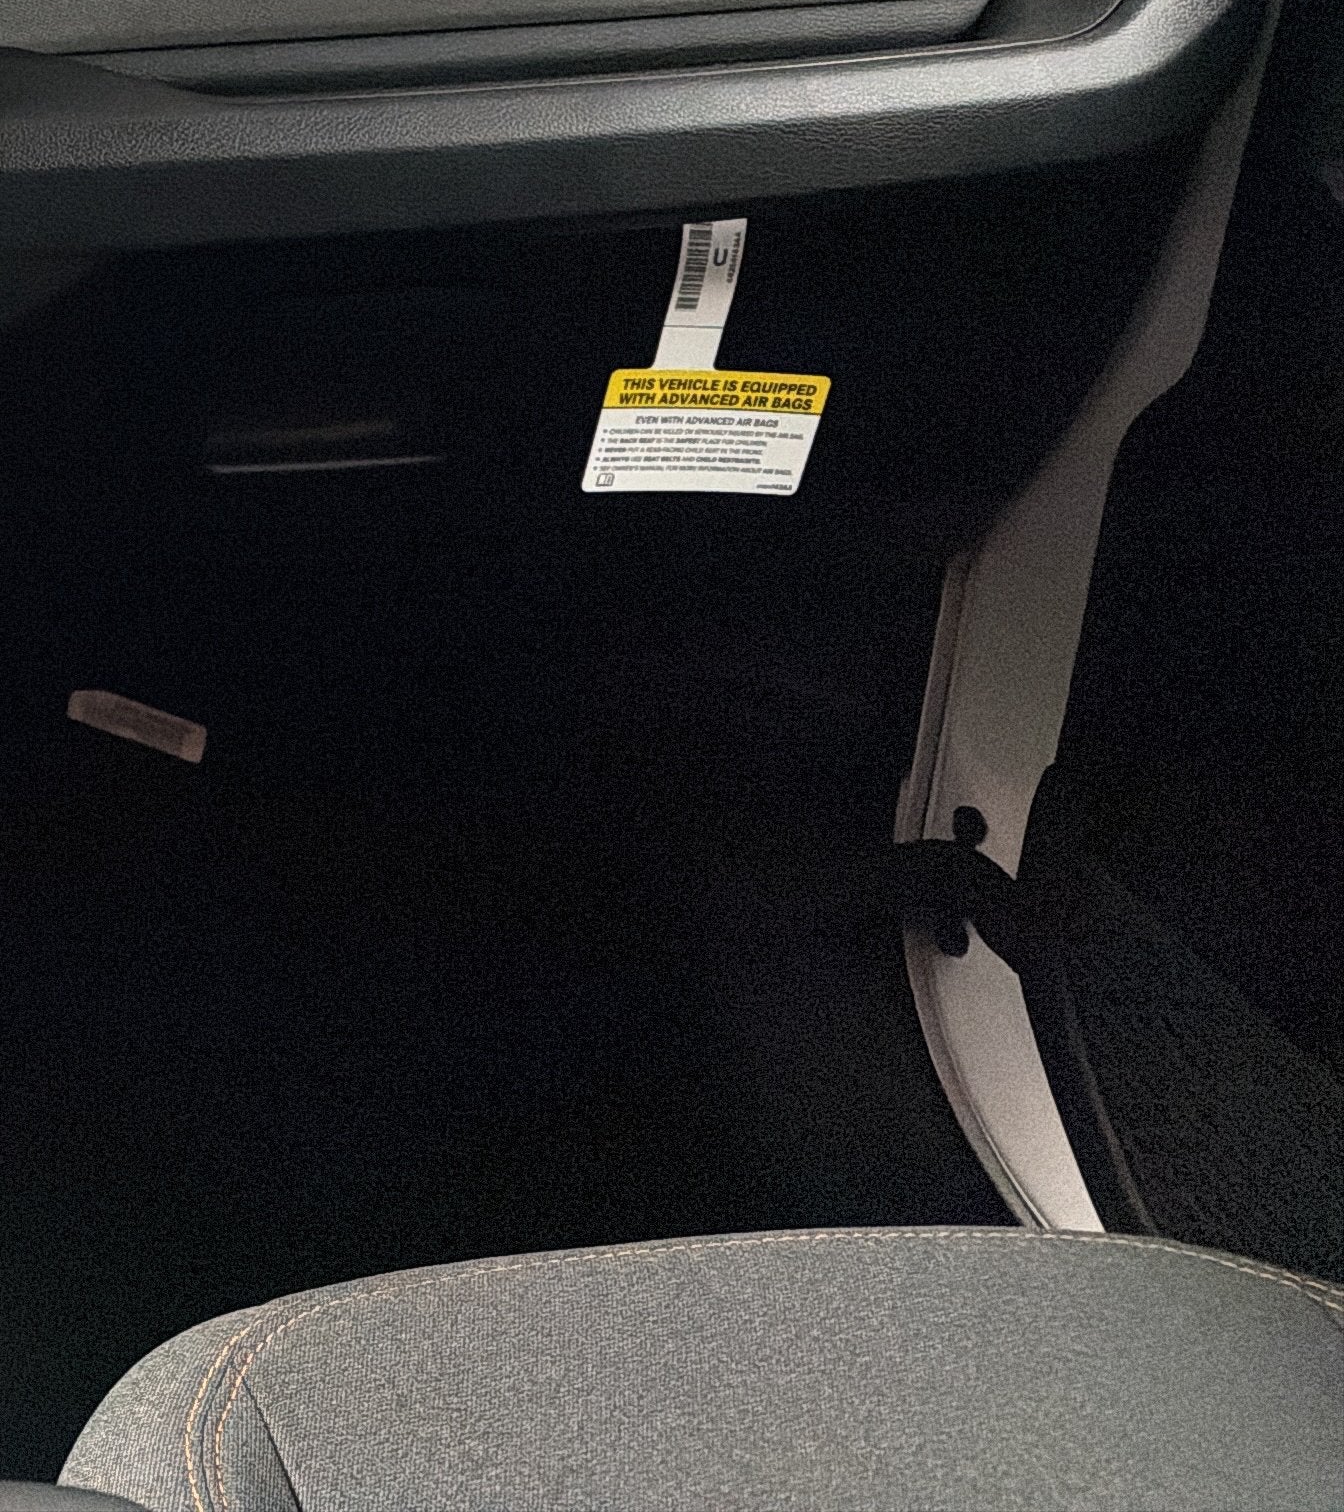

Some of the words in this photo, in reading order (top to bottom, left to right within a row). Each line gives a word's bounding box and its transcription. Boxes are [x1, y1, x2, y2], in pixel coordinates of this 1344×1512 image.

[623, 379, 655, 390] THIS
[659, 380, 720, 391] VEHICLE
[722, 380, 737, 392] IS
[740, 382, 817, 396] EQUIPPED
[619, 393, 656, 405] WITH
[658, 394, 739, 406] ADVANCED
[742, 396, 769, 407] AIR
[772, 397, 813, 410] BAGS
[636, 416, 659, 424] EVEN
[661, 416, 684, 424] WITH
[686, 417, 734, 425] ADVANCED
[737, 418, 753, 426] AIR
[754, 418, 778, 428] BAGS
